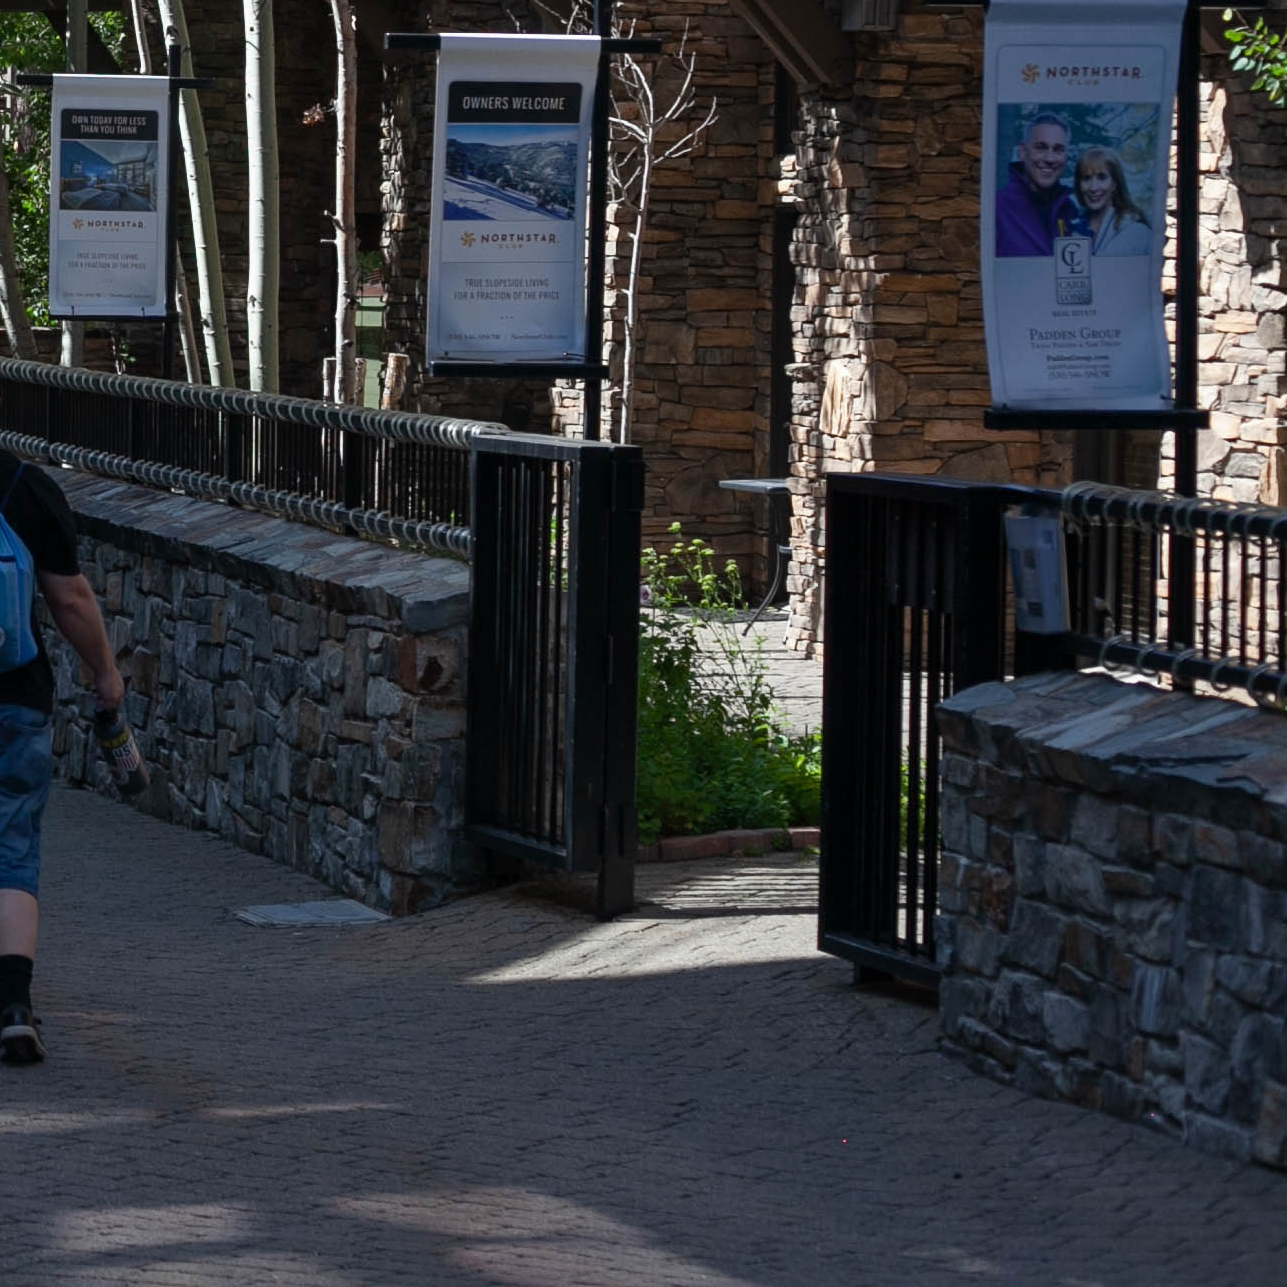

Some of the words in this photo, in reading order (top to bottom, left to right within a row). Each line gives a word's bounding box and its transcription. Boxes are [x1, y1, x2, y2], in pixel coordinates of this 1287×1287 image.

[1046, 66, 1141, 79] NORTHSTAR
[462, 96, 509, 110] OWNERS
[512, 97, 566, 111] WELCOME
[72, 115, 88, 125] OWN
[90, 115, 112, 125] TODAY
[114, 116, 128, 125] FOR
[129, 117, 146, 126] LESS
[80, 125, 99, 133] THAN
[100, 125, 115, 134] YOU
[117, 126, 138, 135] THINK
[88, 220, 144, 229] NORTHSTAR
[481, 233, 557, 244] NORTHSTAR
[1030, 328, 1076, 341] PADDEN
[1080, 327, 1122, 339] GROUP
